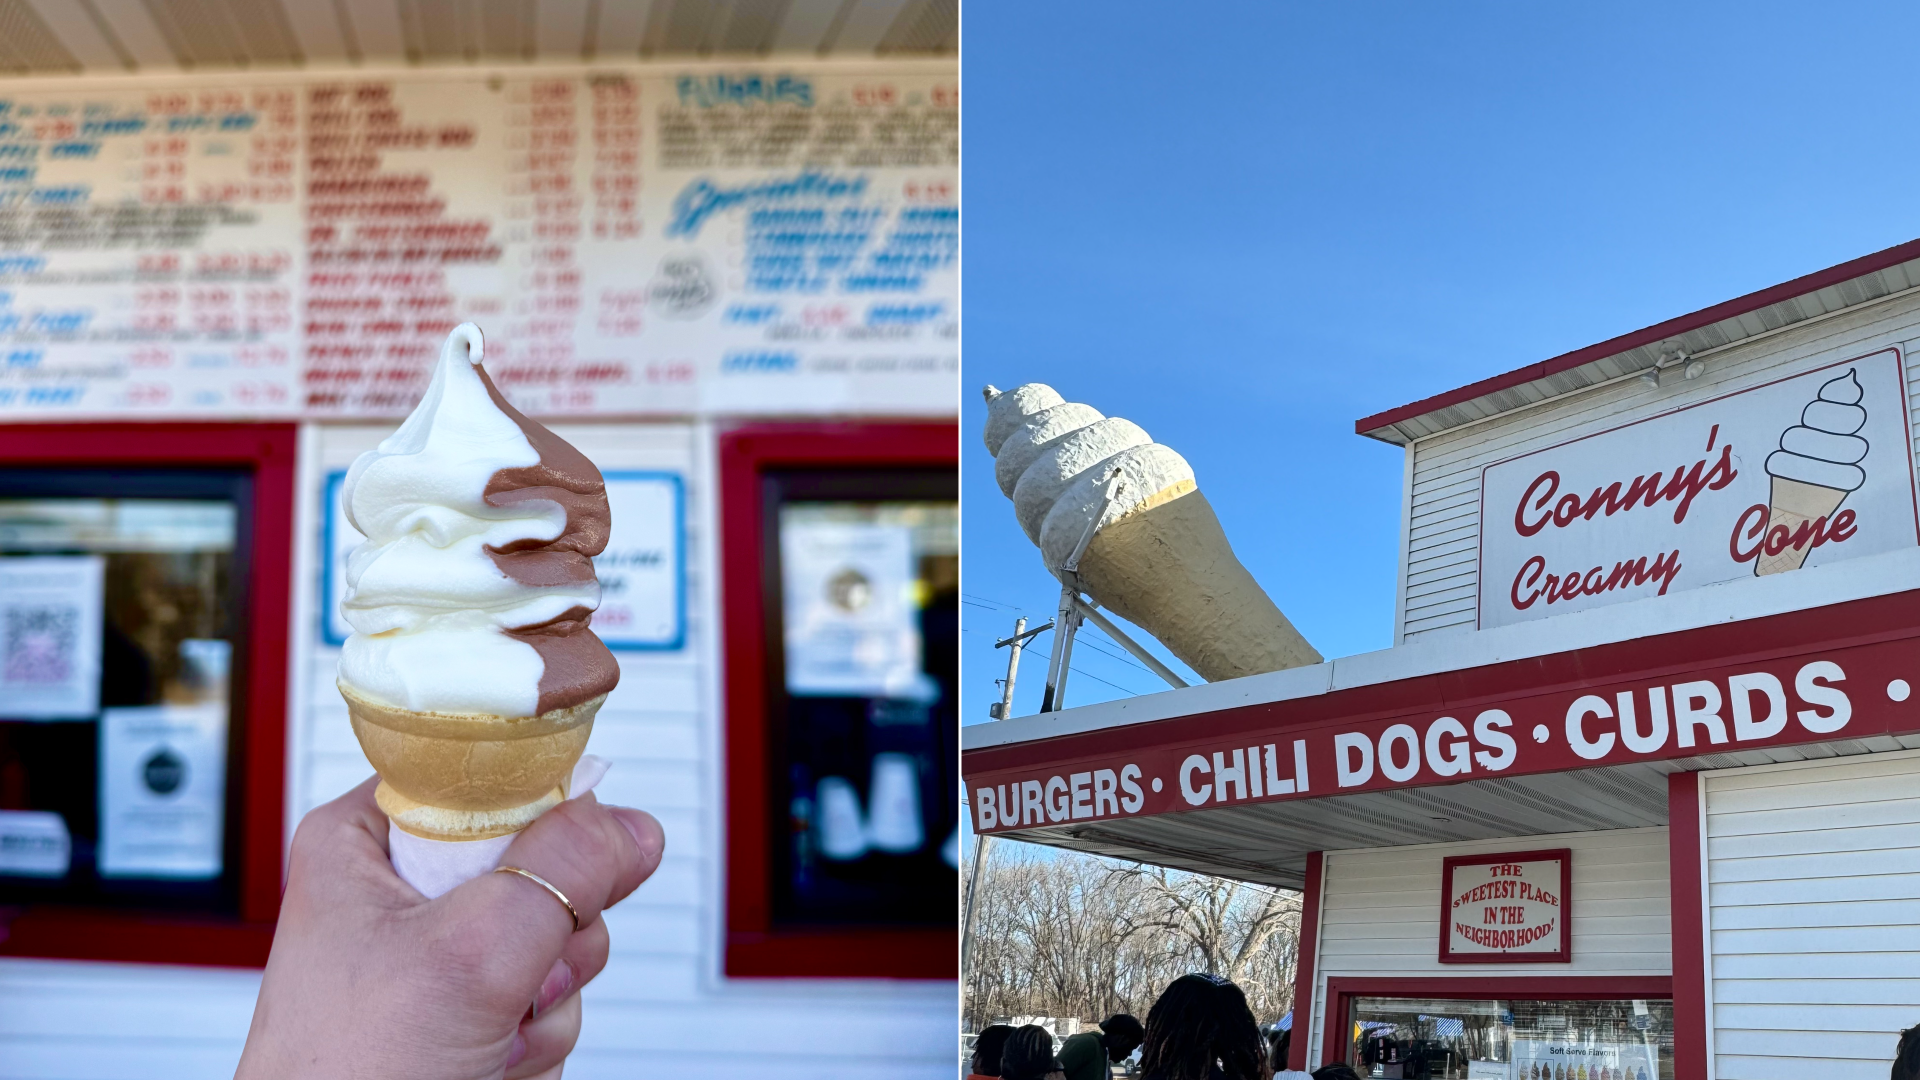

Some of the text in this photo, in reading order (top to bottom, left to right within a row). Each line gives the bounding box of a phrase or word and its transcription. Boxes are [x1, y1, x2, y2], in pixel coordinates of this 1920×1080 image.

[1514, 424, 1739, 537] Conny's
[1511, 503, 1859, 611] Creamy Cone
[977, 660, 1852, 830] BURGERS CHILI DOGS CURDS
[1490, 865, 1522, 877] THE
[1453, 880, 1558, 908] SWEETEST PLACE
[1484, 906, 1524, 924] IN THE
[1456, 918, 1554, 948] NEIGHBORHOOD!
[1550, 1047, 1616, 1057] Soft Serve Flavors
